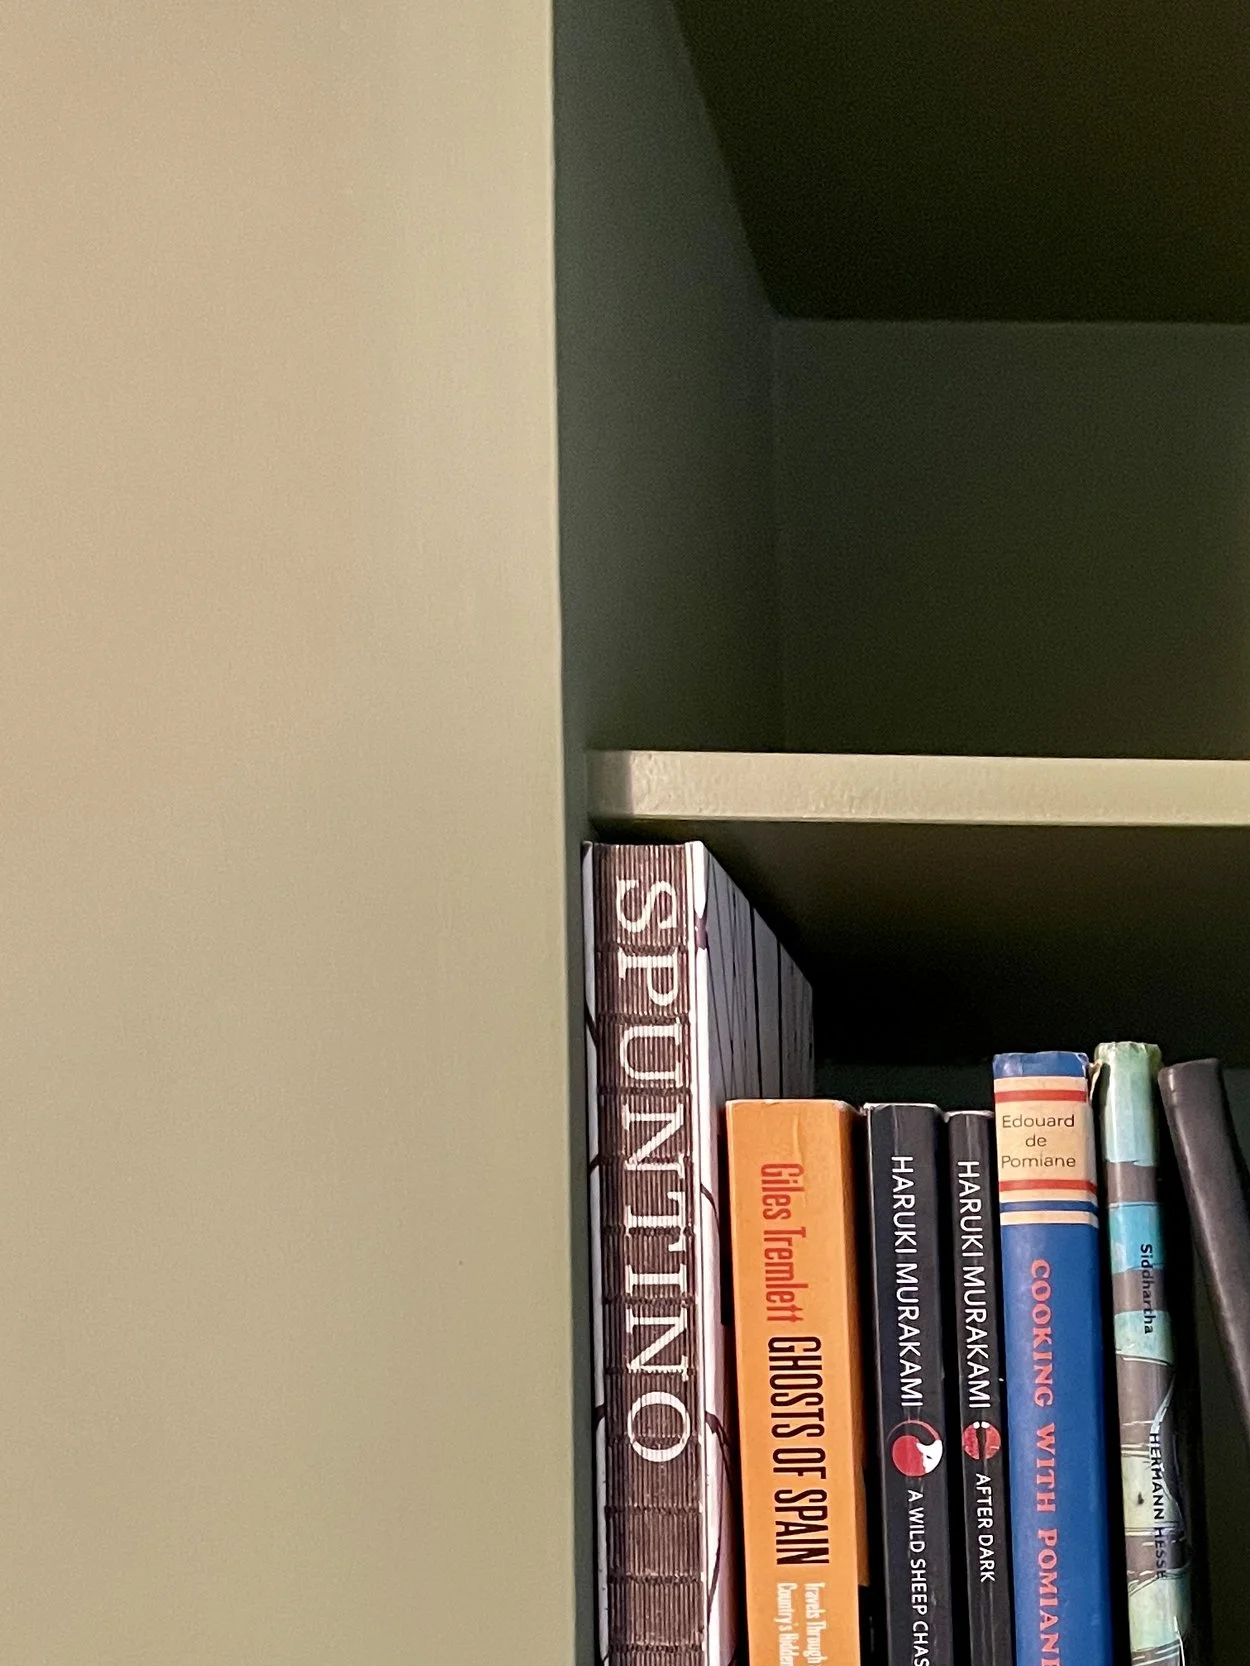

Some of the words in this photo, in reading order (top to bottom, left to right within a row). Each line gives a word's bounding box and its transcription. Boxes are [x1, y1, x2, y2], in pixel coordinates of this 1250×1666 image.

[1002, 1114, 1075, 1128] Edouard
[1025, 1134, 1047, 1147] de
[616, 878, 691, 1463] SPUNTINO
[1001, 1154, 1076, 1169] Pomiane
[761, 1163, 805, 1220] Giles
[891, 1156, 917, 1254] HARUKI
[957, 1161, 984, 1257] HARUKI
[764, 1226, 809, 1323] Tremlett
[1140, 1243, 1157, 1335] Siddhartha
[896, 1263, 923, 1407] MURAKAMI
[962, 1266, 991, 1408] MURAKAMI
[1031, 1259, 1053, 1408] COOKING
[768, 1336, 825, 1438] GHOSTS
[772, 1447, 827, 1480] OF
[1036, 1423, 1056, 1513] WITH
[1150, 1433, 1165, 1520] HERMANN
[907, 1489, 924, 1502] A
[975, 1473, 994, 1529] AFTER
[774, 1489, 830, 1565] SPAIN
[908, 1507, 925, 1553] WILD
[1154, 1527, 1167, 1579] HESSE
[978, 1534, 996, 1583] DARK
[773, 1583, 799, 1631] Country's
[804, 1583, 826, 1619] Travels
[910, 1559, 928, 1615] SHEEP
[803, 1620, 828, 1664] Through
